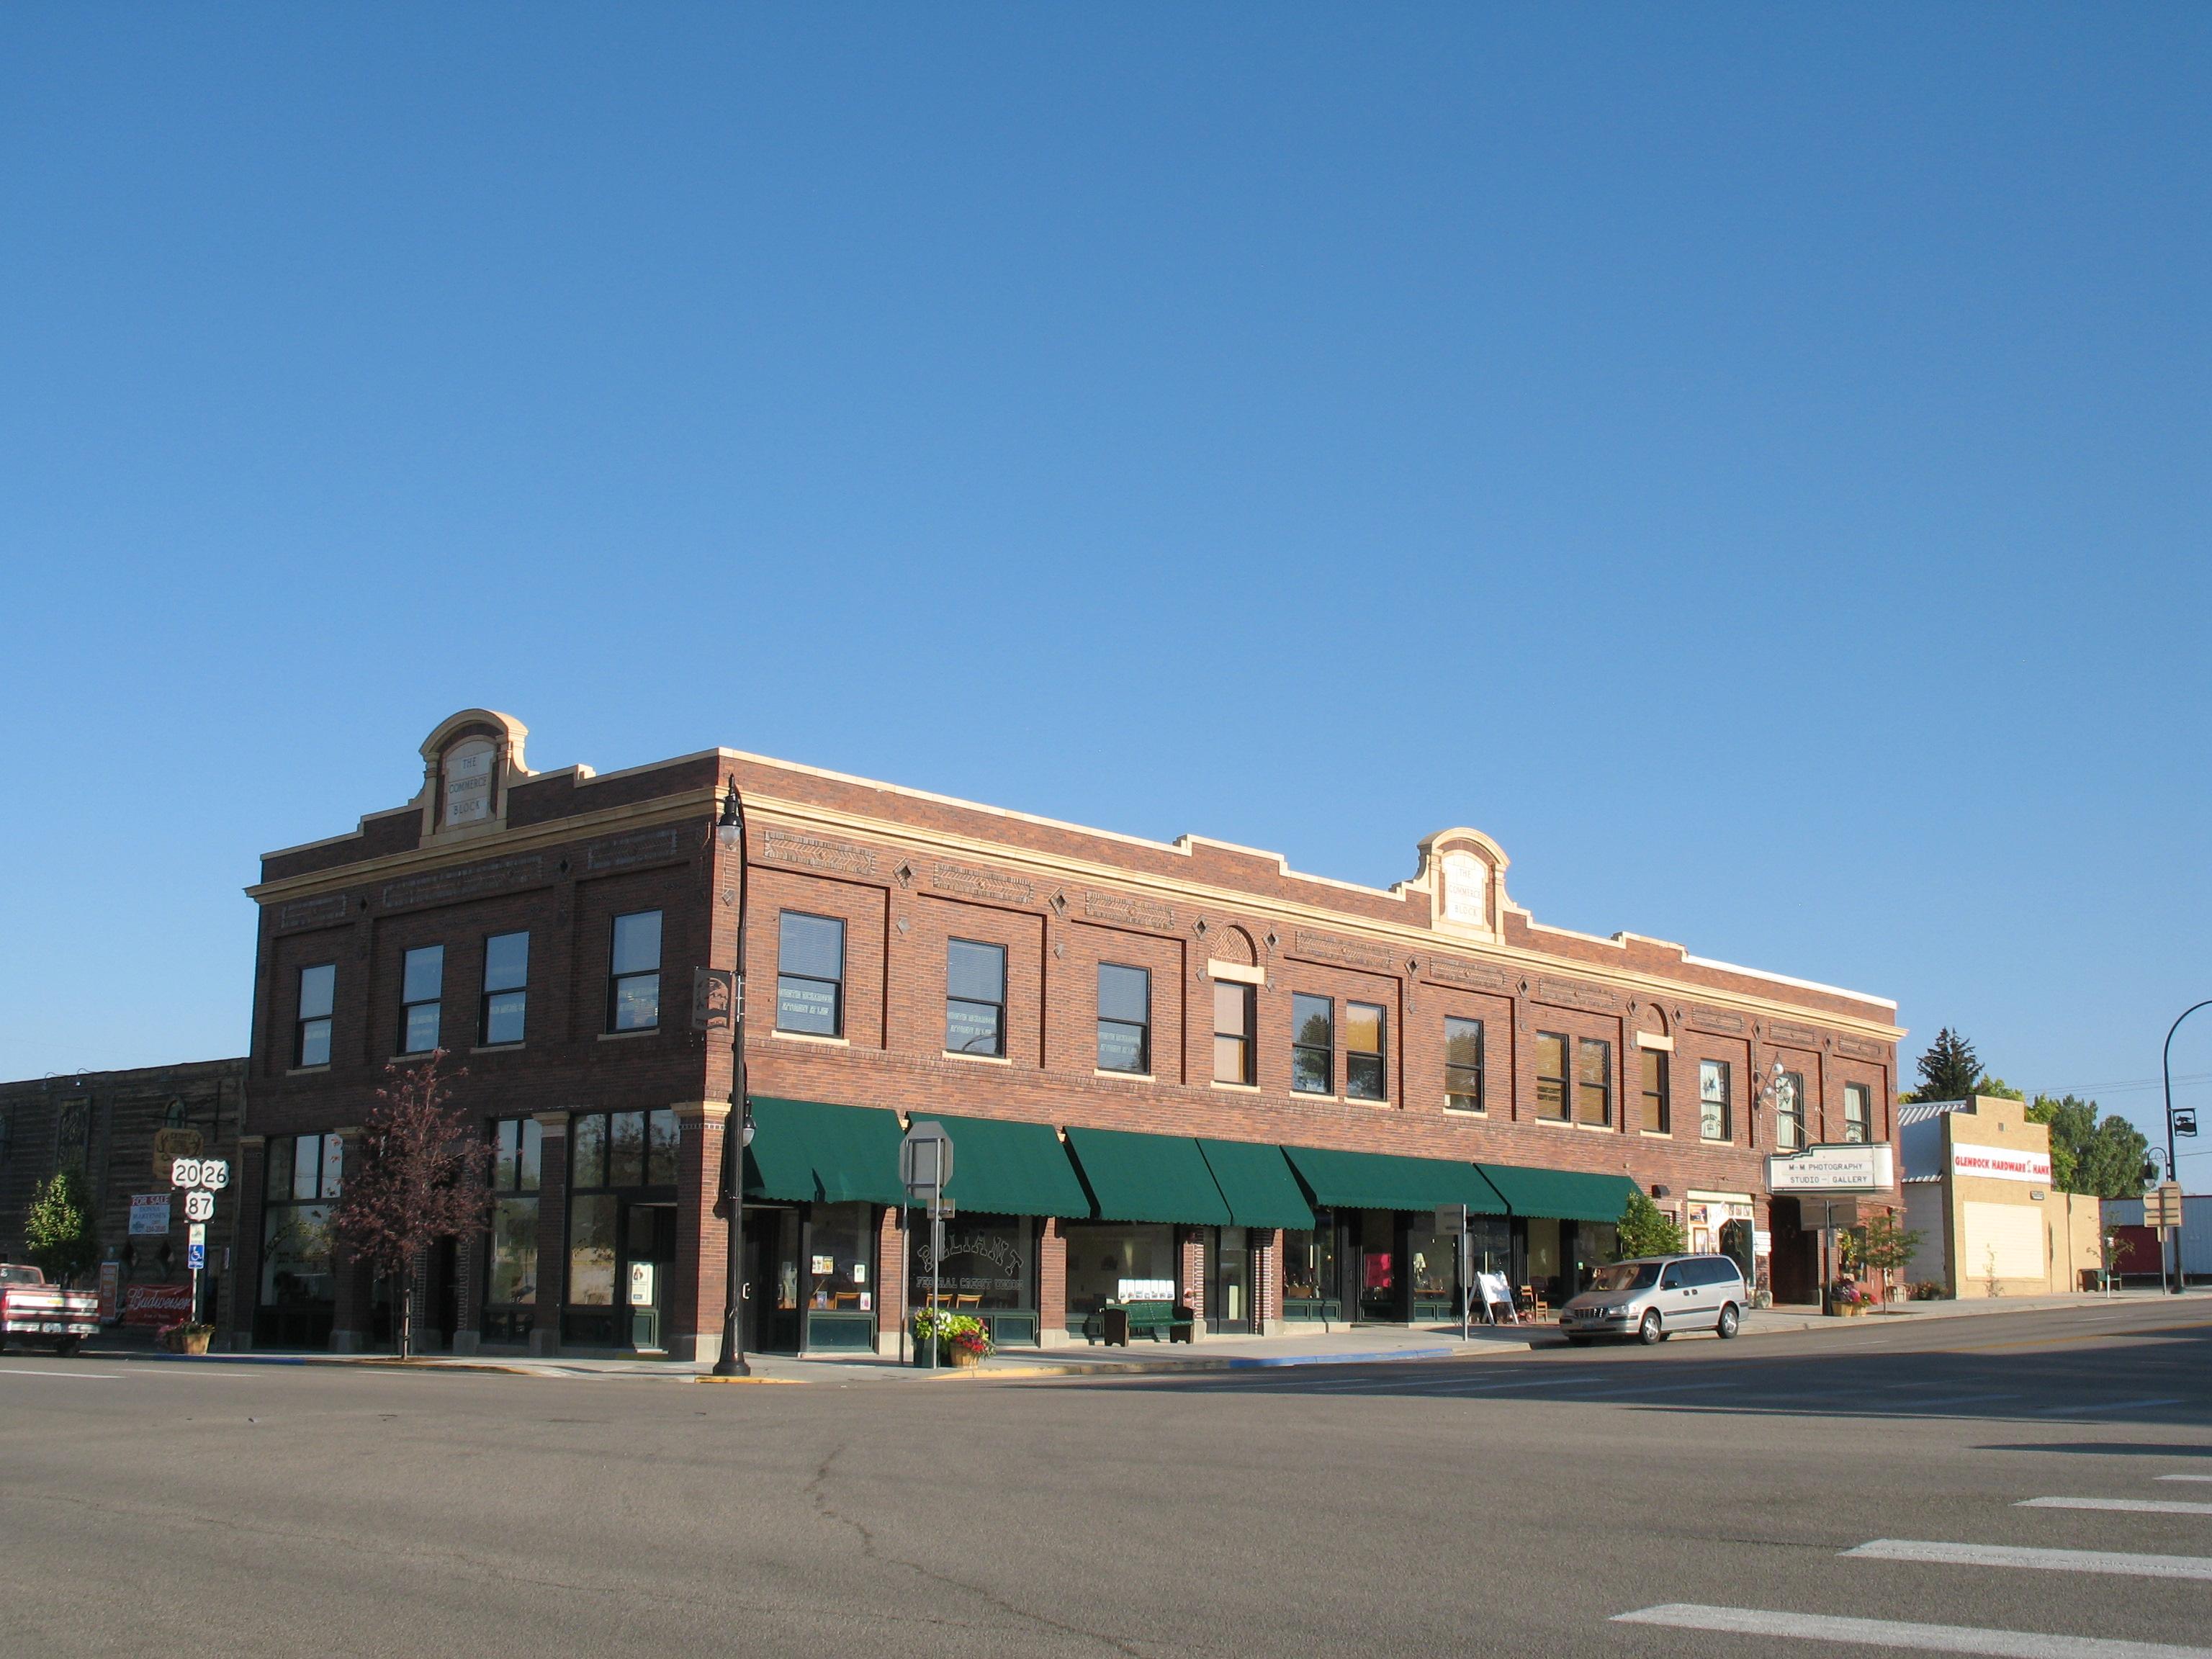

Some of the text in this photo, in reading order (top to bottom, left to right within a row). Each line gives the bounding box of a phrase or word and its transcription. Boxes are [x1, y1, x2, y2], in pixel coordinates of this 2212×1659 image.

[462, 757, 477, 770] THE
[449, 777, 487, 794] COMMERCE
[454, 800, 480, 815] BLOCK
[1459, 868, 1471, 878] THE
[1449, 884, 1481, 899] COMMERCE
[1455, 904, 1478, 917] BLOCK
[176, 1164, 197, 1182] 20
[1955, 1156, 2049, 1175] GLENROCK HARDWARE HANK
[204, 1166, 227, 1184] 26
[1832, 1175, 1867, 1184] GALLERY
[132, 1195, 169, 1206] FOR SALE
[189, 1197, 210, 1215] 87
[916, 1277, 1024, 1290] FEDRAL CREDIT UNION
[127, 1287, 191, 1310] Budweiser
